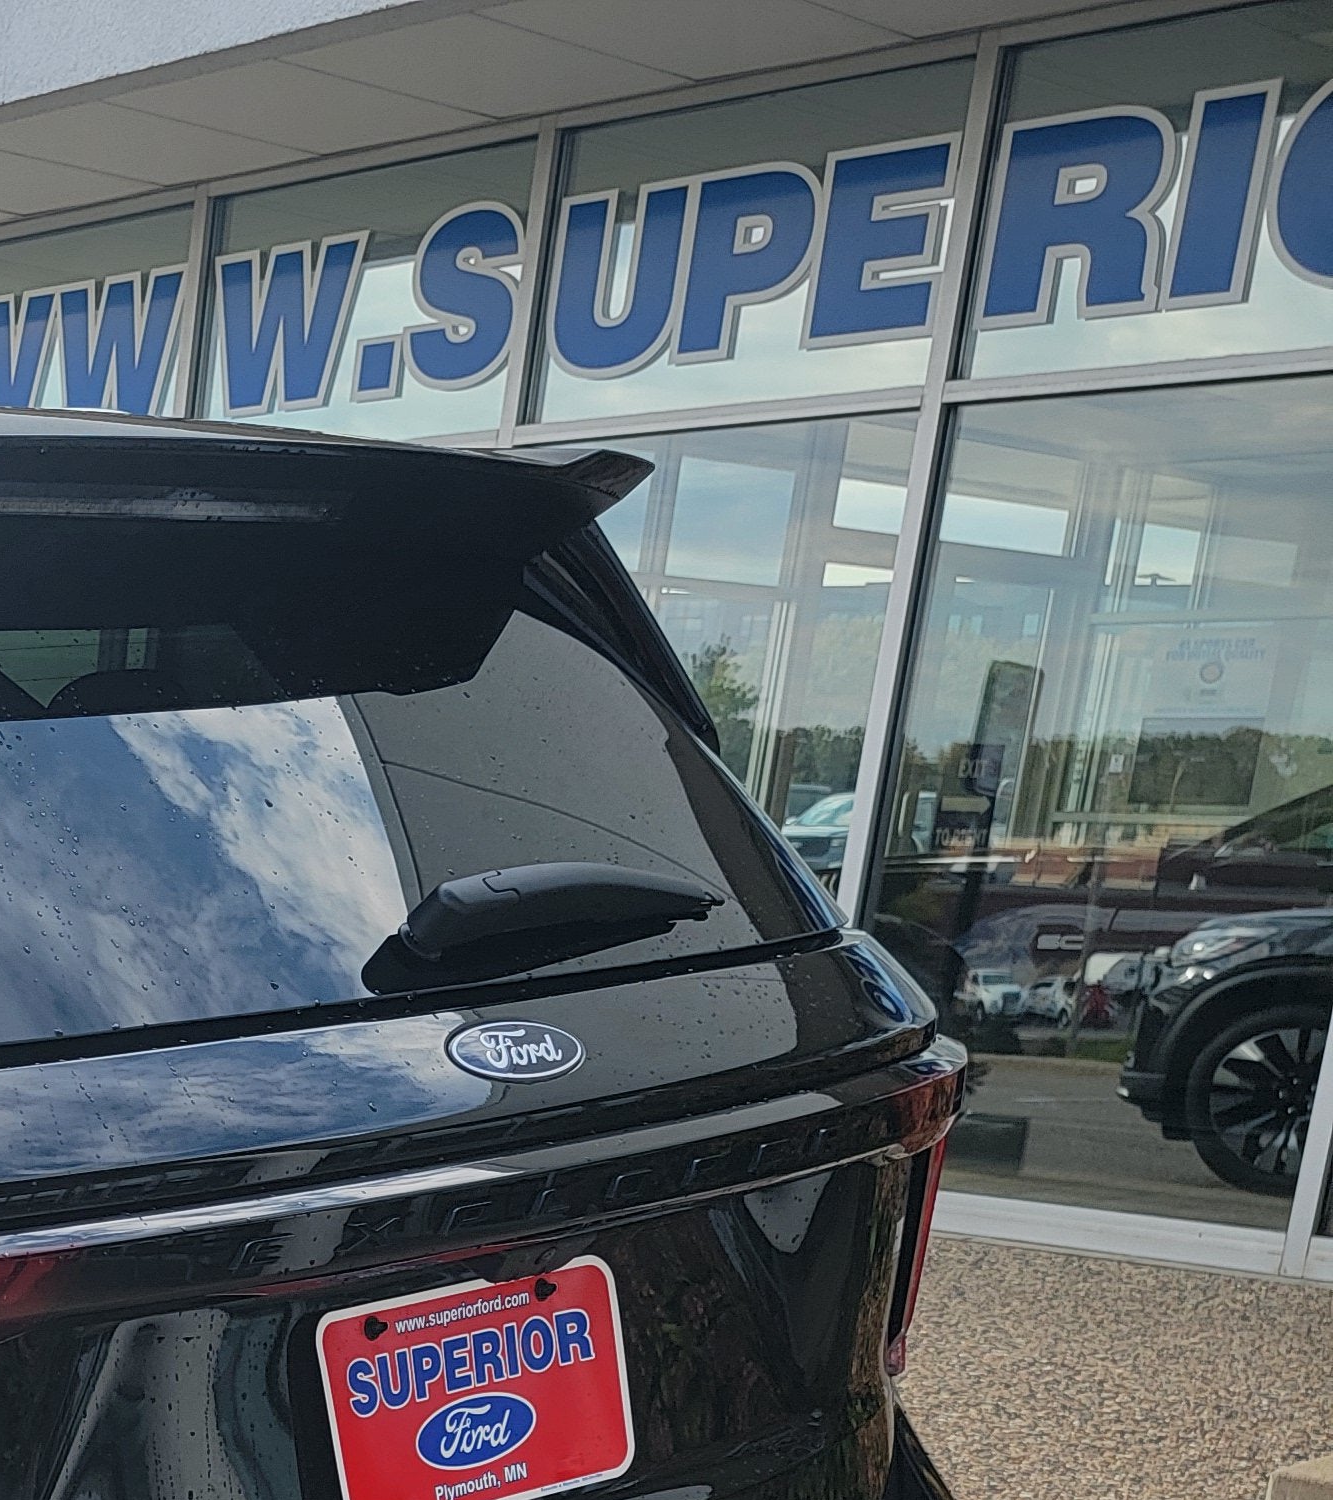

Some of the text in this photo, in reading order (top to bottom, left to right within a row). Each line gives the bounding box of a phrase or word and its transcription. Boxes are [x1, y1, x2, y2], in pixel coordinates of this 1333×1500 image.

[479, 1028, 563, 1069] Ford
[395, 1291, 531, 1335] www.superiorford.com
[346, 1308, 596, 1418] SUPERIOR
[439, 1402, 513, 1459] Ford
[504, 1462, 529, 1484] MN
